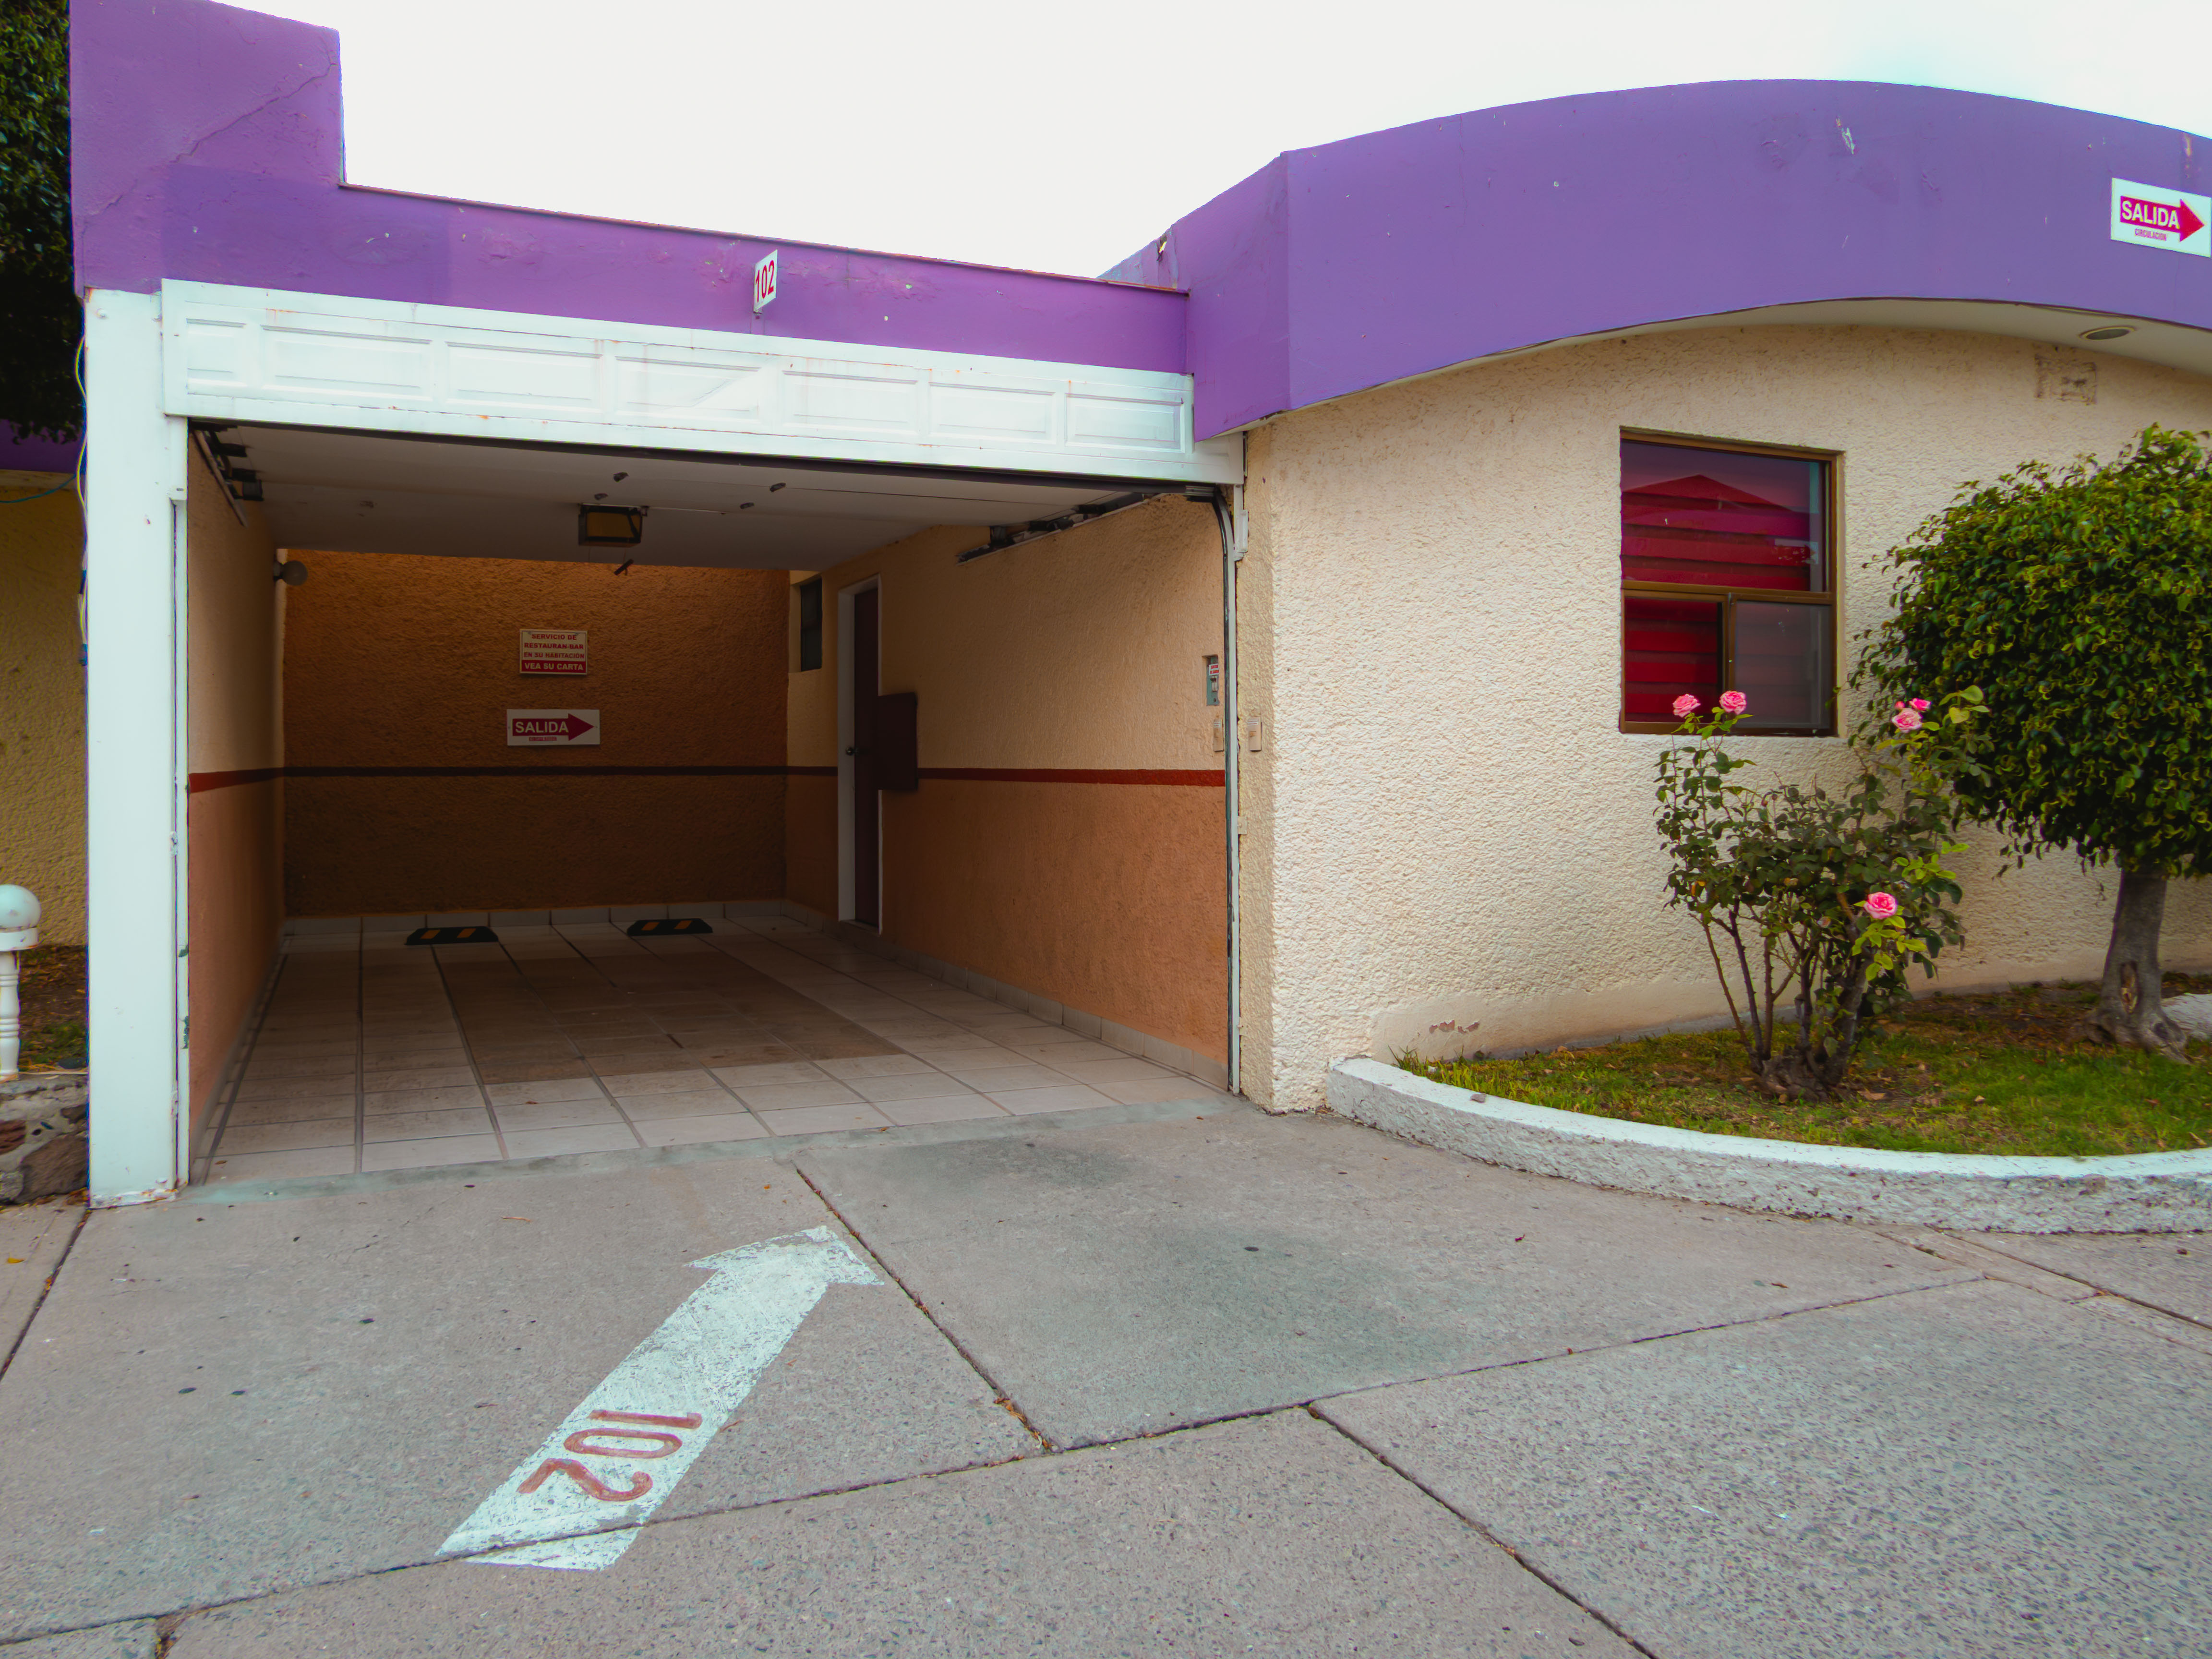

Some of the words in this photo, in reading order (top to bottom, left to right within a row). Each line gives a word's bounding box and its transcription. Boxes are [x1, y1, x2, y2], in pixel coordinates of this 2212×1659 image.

[2122, 200, 2180, 229] SALIDA
[755, 260, 775, 302] 102
[515, 721, 569, 733] SALIDA
[516, 1409, 703, 1502] 102
